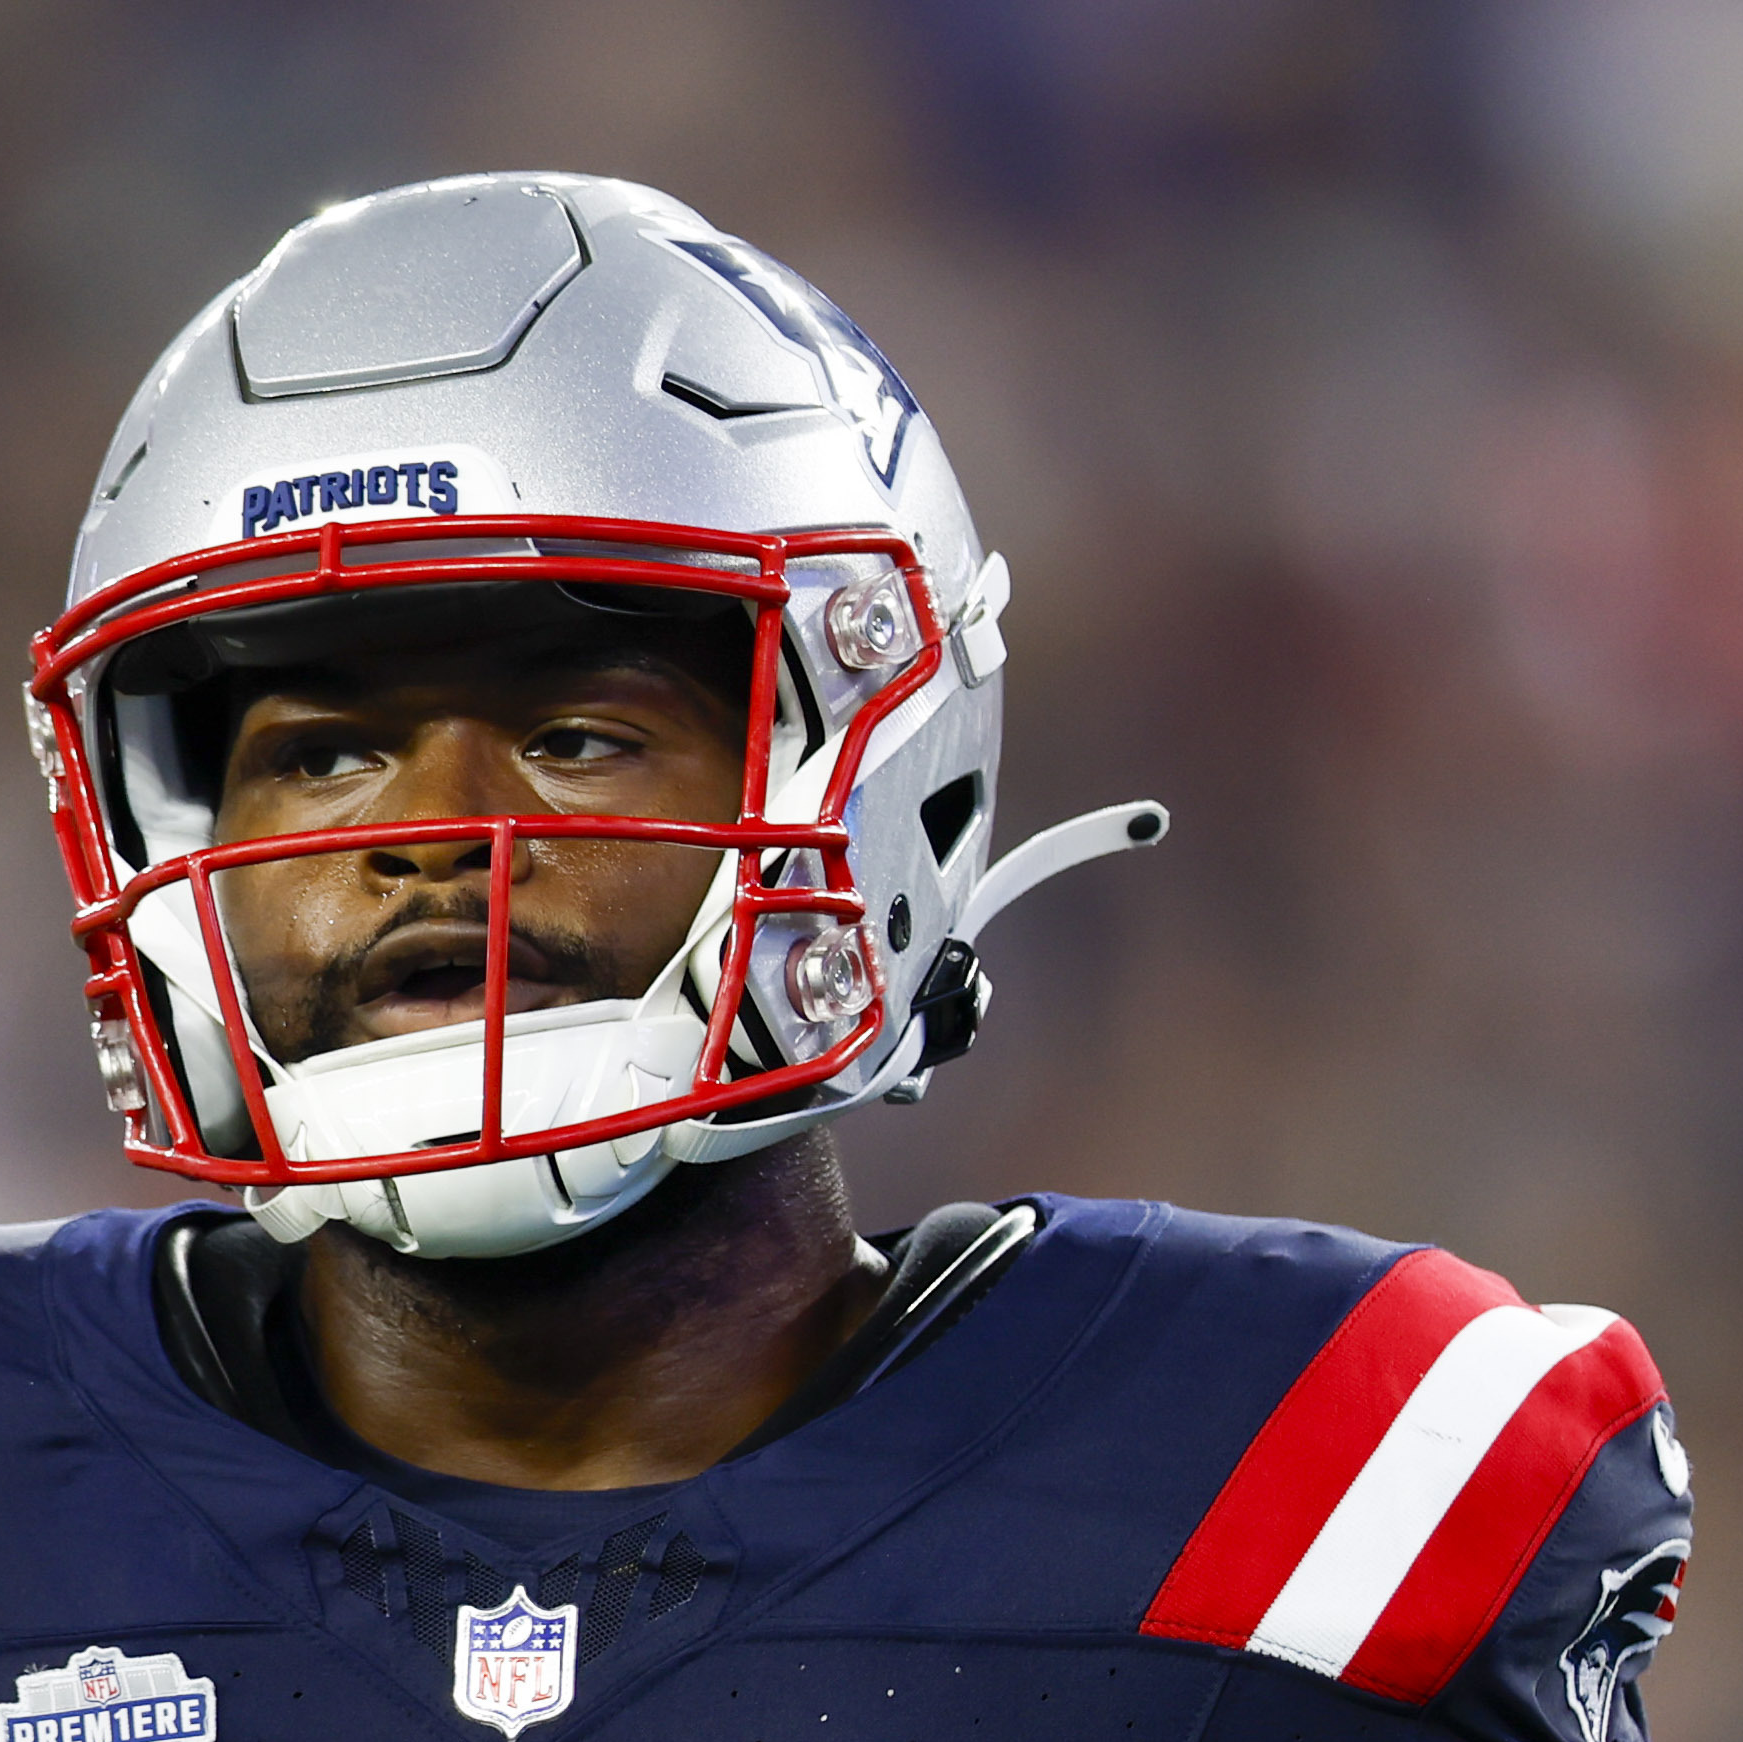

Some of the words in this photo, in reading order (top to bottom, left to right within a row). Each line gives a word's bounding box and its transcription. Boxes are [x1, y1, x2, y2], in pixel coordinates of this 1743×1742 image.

[242, 461, 458, 539] PATRIOTS
[83, 1675, 119, 1701] NFL
[476, 1656, 553, 1708] NFL
